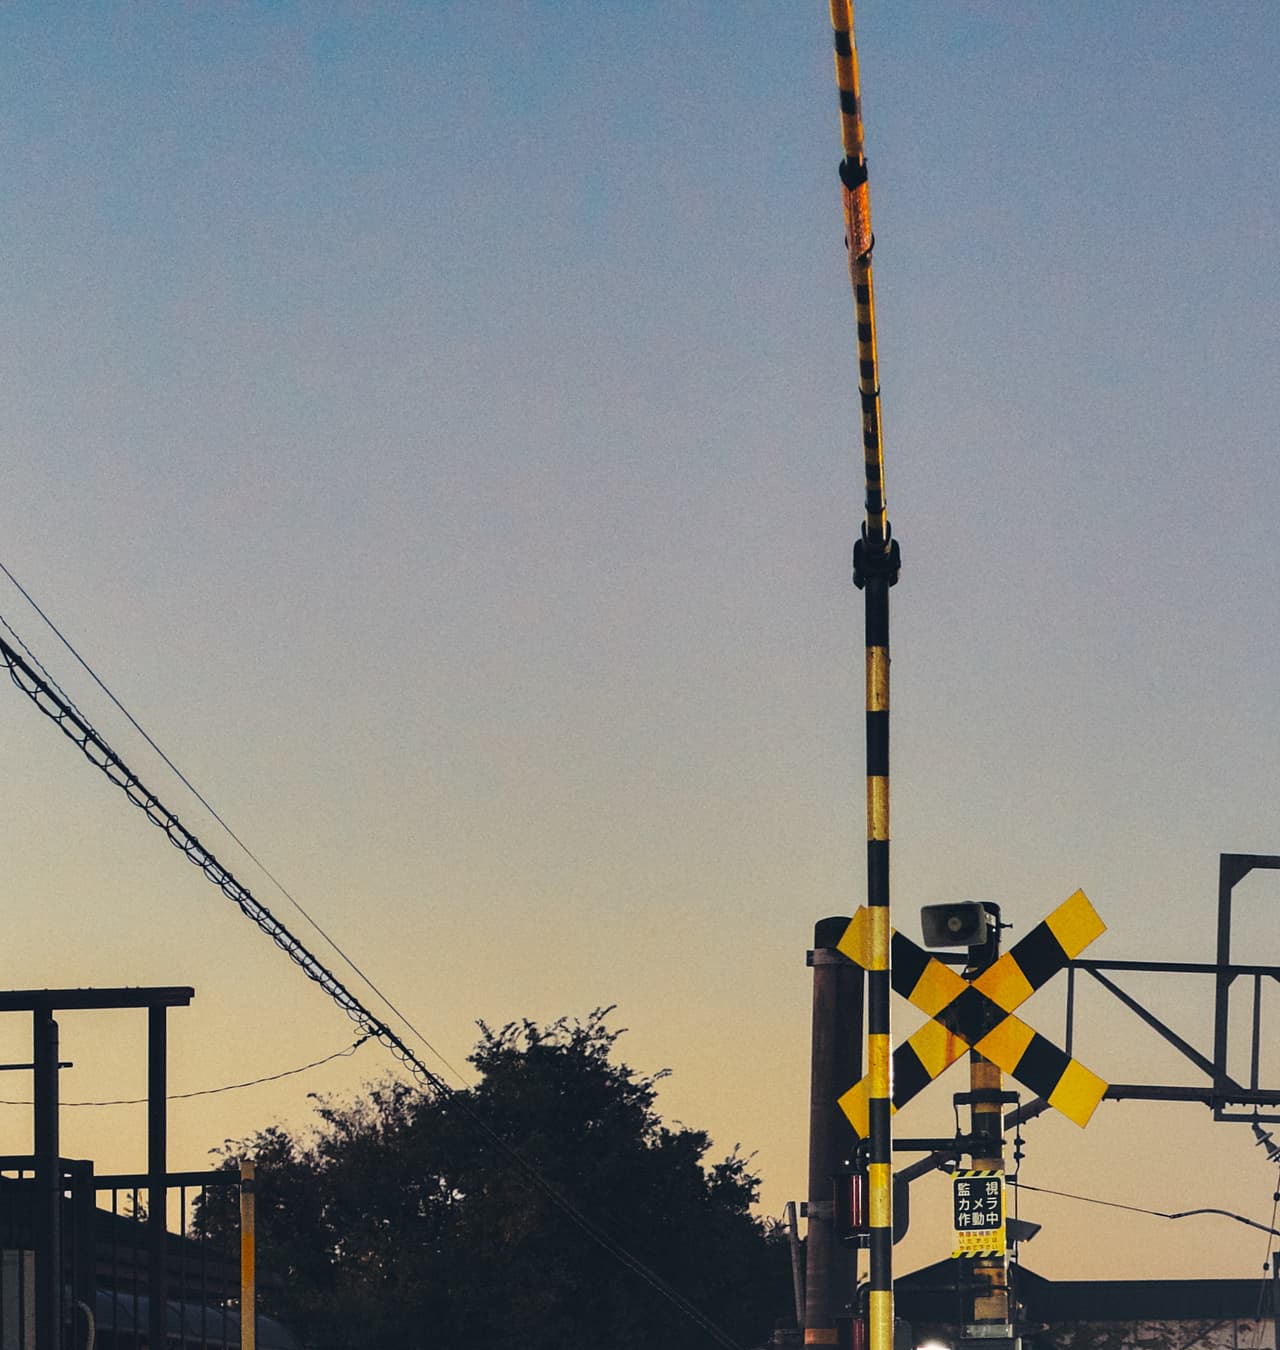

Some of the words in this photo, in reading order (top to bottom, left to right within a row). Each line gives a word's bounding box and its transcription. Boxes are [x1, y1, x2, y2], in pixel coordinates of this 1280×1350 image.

[958, 1182, 998, 1196] 監視
[959, 1197, 998, 1210] カメラ
[959, 1212, 998, 1226] 作動中
